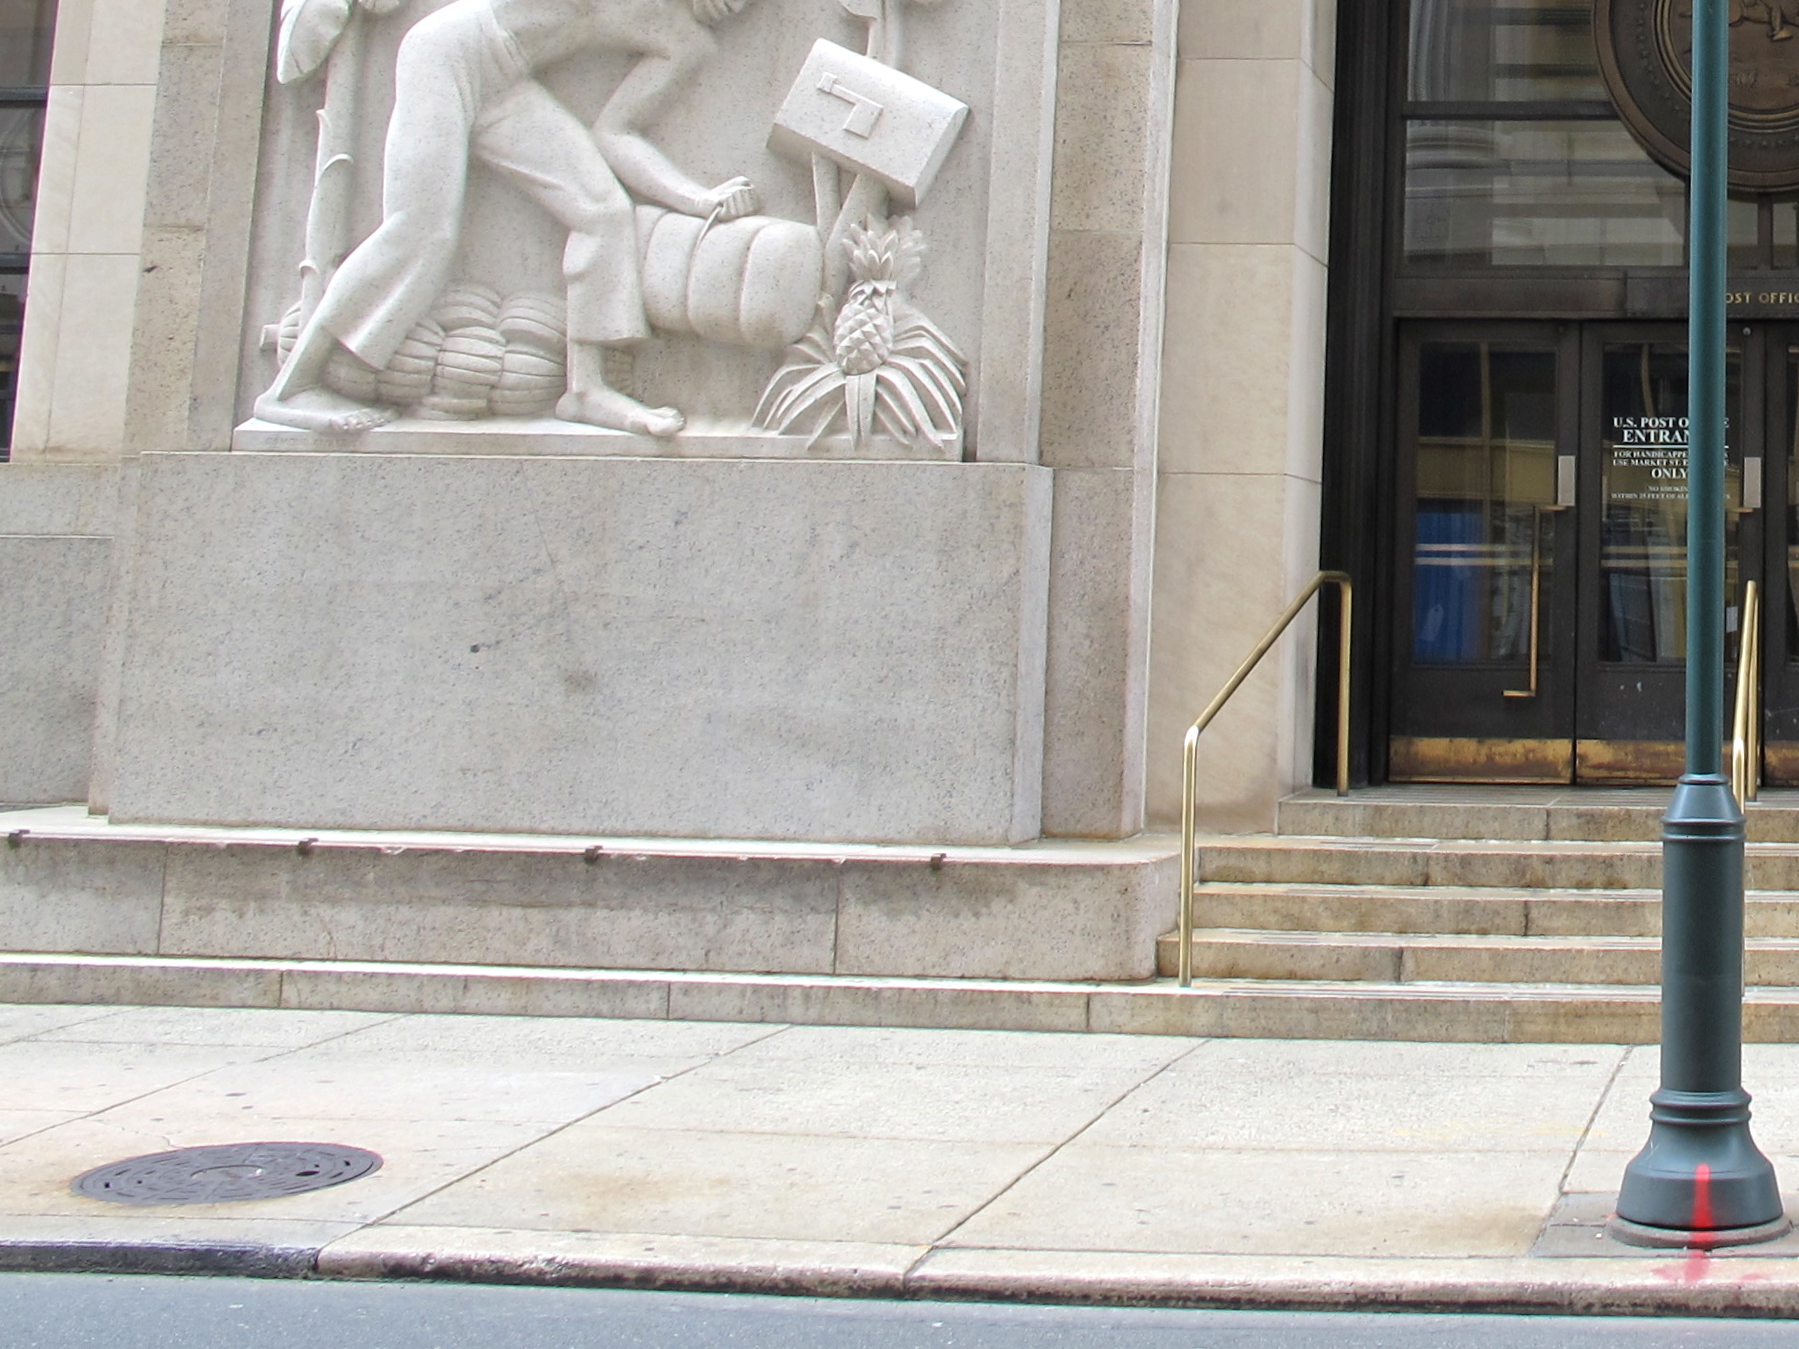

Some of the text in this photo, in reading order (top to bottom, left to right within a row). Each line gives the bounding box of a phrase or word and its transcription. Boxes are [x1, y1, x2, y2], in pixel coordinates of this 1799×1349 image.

[1725, 292, 1751, 304] OST
[1613, 417, 1637, 428] U.S.
[1640, 417, 1676, 428] POST
[1623, 429, 1690, 443] ENTRAN
[1651, 468, 1688, 479] ONLY
